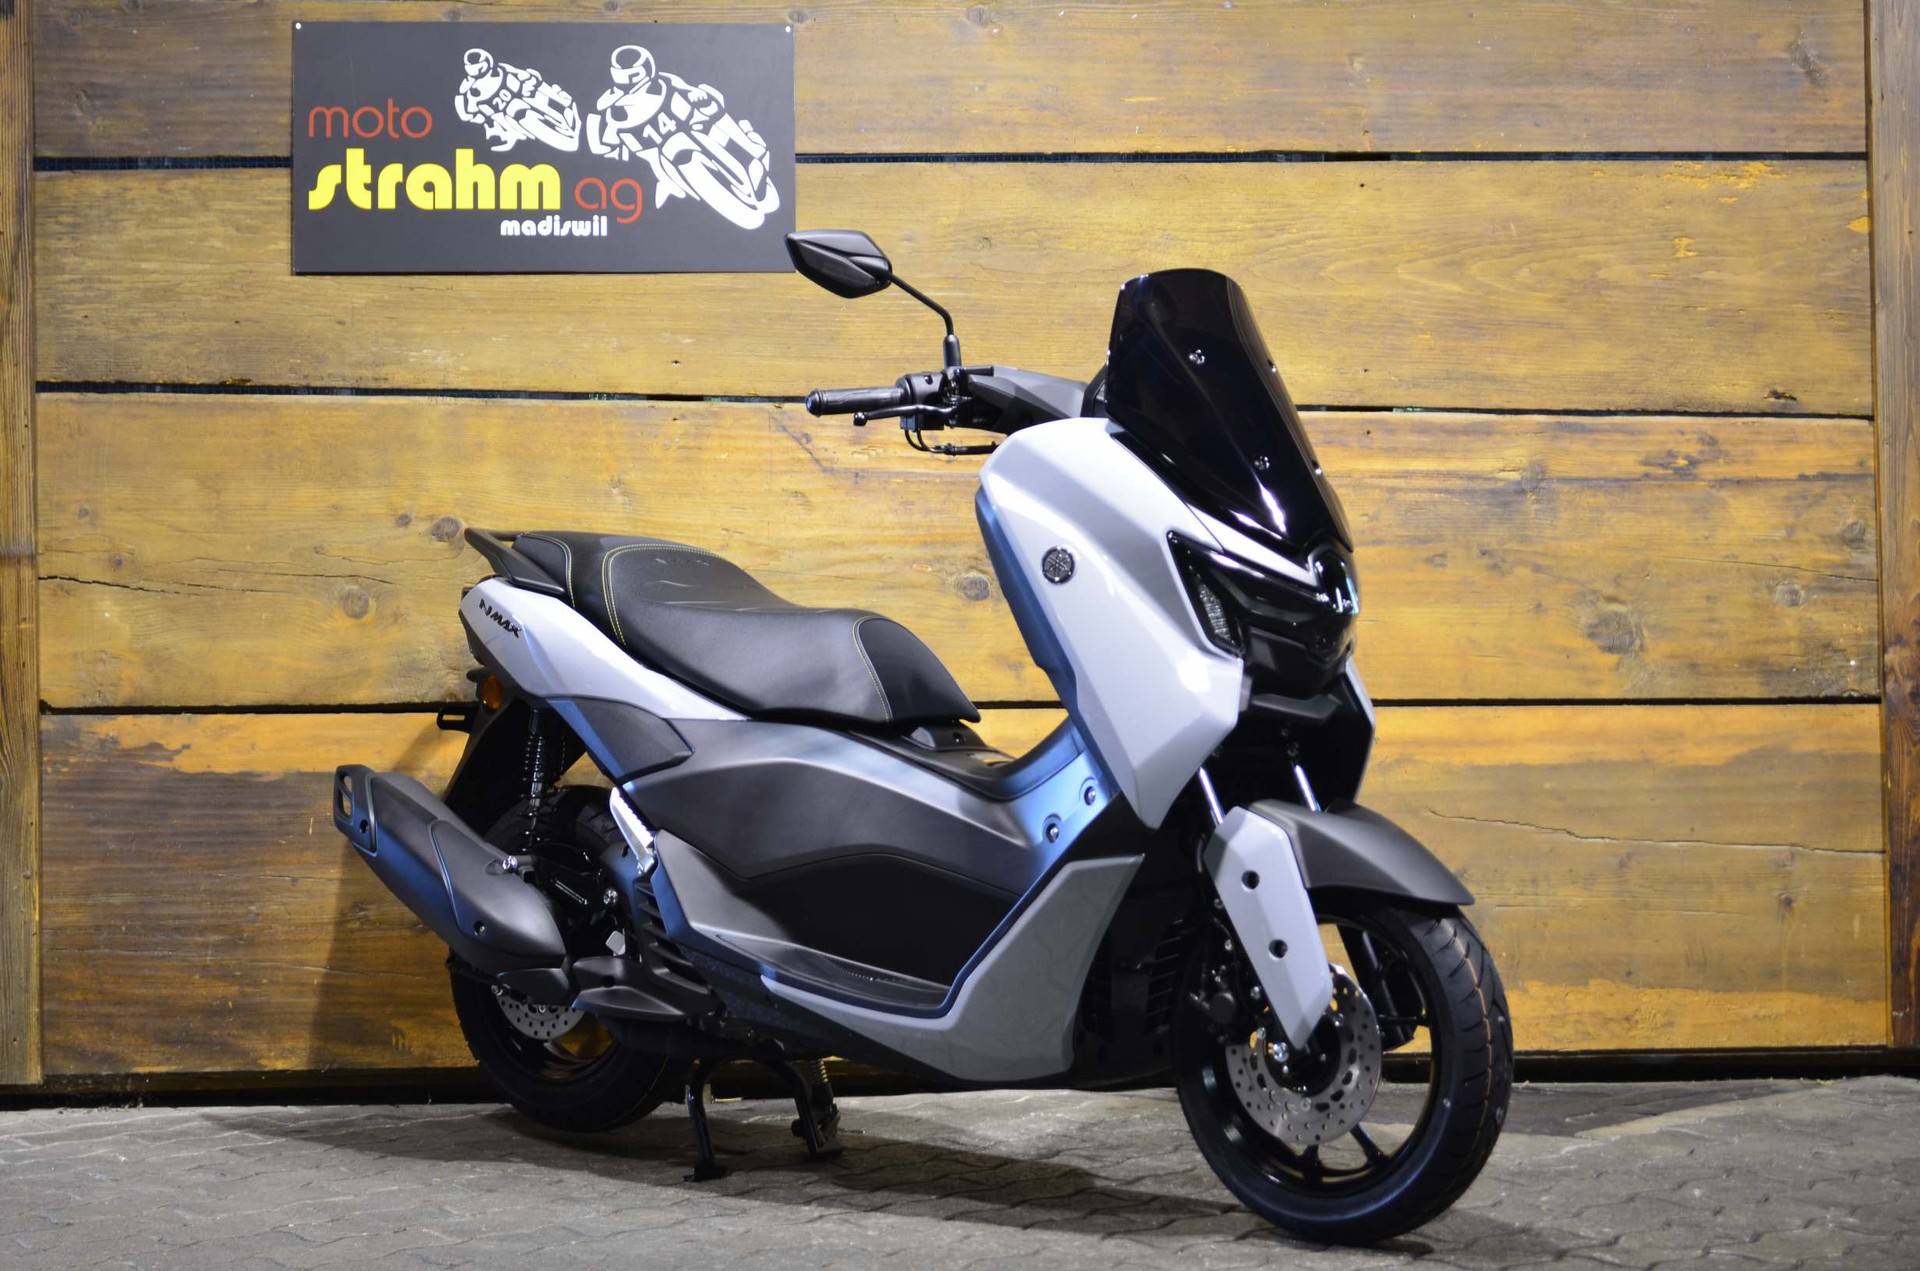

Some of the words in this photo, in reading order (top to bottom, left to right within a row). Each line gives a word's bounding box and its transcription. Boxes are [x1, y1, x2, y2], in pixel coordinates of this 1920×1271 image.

[492, 89, 512, 110] 20
[308, 99, 432, 138] moto
[642, 111, 677, 145] 14
[308, 148, 561, 210] strahm
[574, 177, 643, 223] ag
[501, 215, 608, 236] madiswil
[479, 599, 522, 638] NMAX
